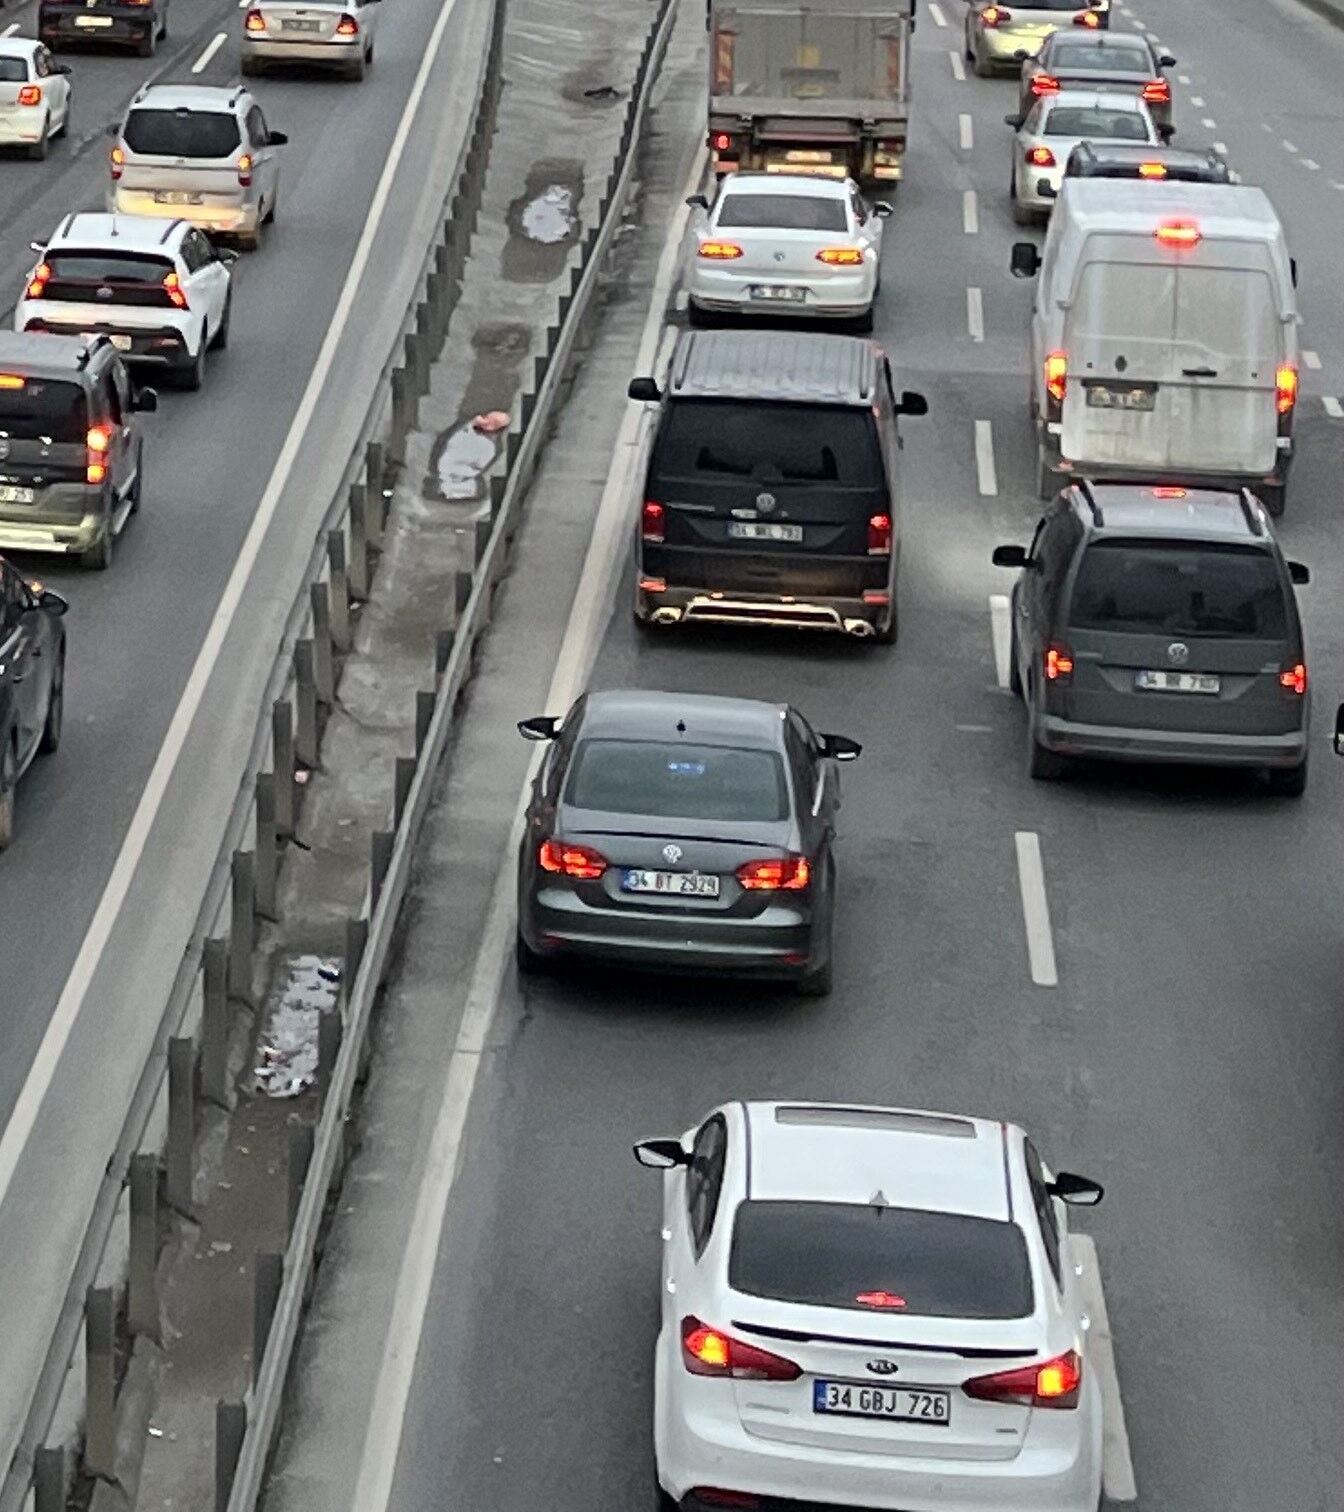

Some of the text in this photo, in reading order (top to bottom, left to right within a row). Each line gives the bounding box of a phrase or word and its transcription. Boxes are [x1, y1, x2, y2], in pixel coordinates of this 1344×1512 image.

[828, 1387, 945, 1418] 34 GBJ 726
